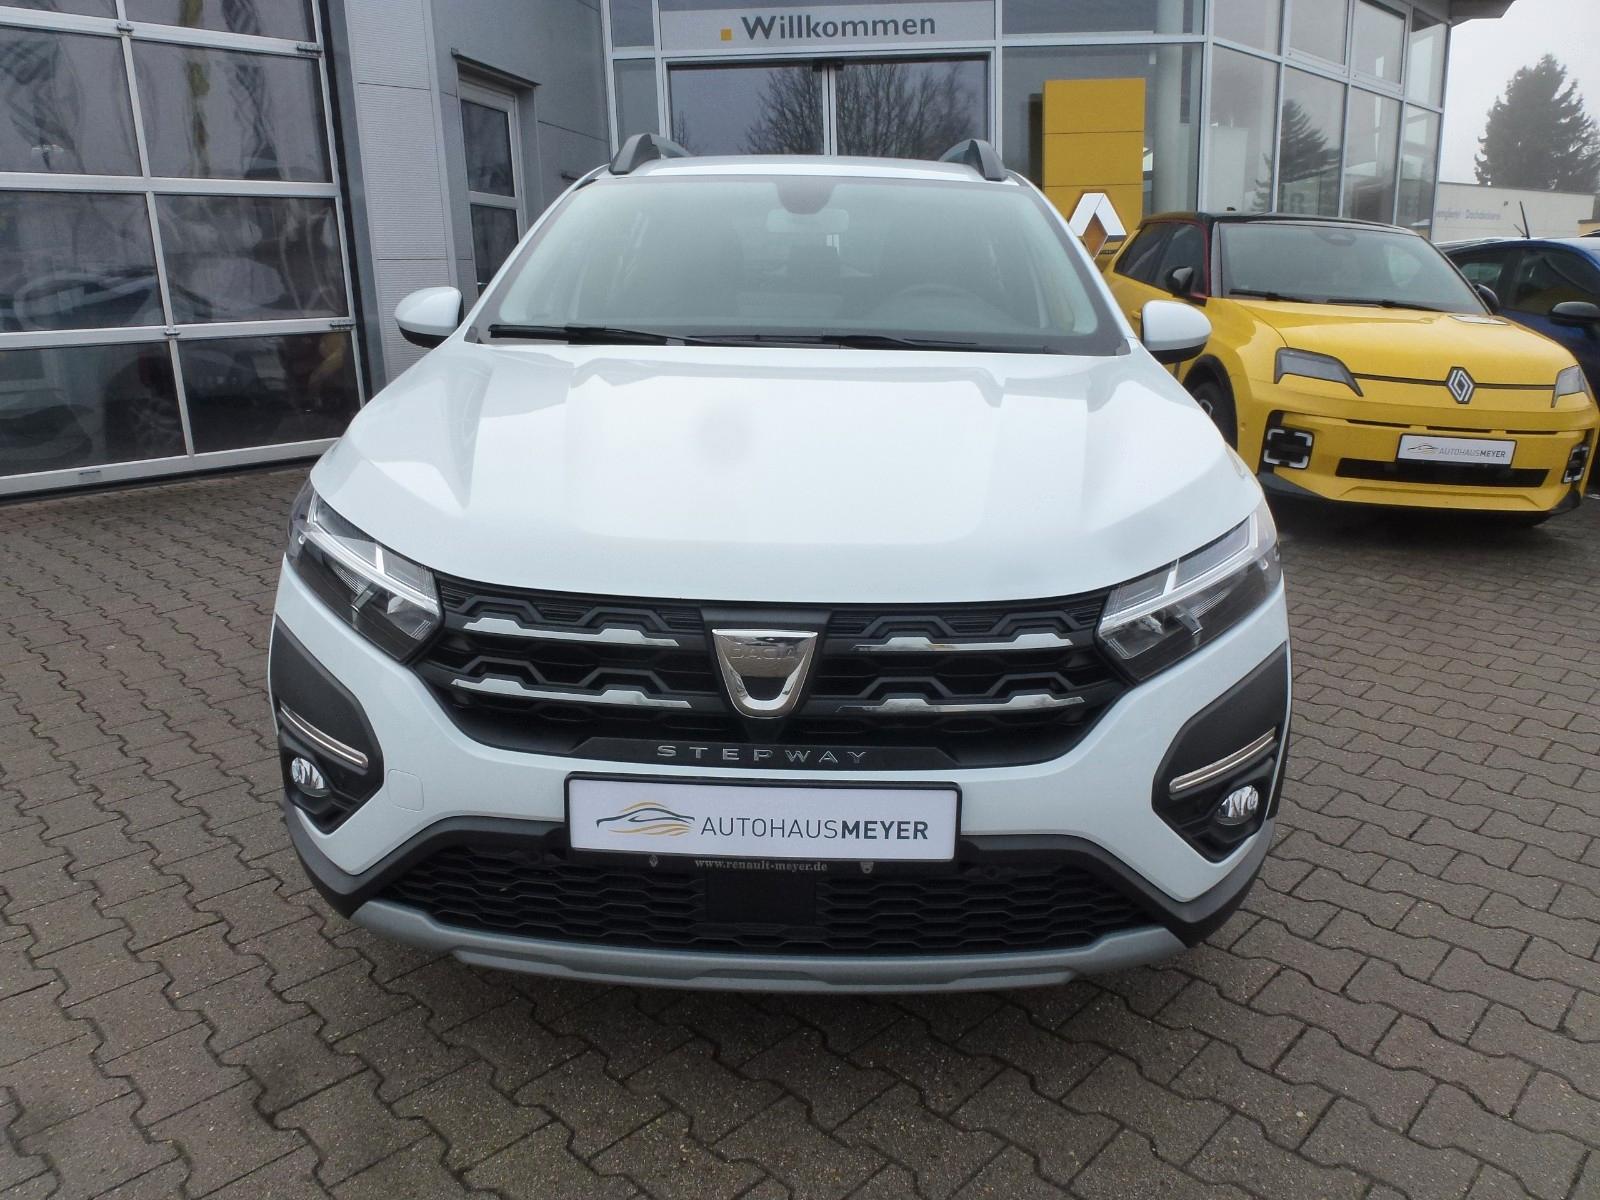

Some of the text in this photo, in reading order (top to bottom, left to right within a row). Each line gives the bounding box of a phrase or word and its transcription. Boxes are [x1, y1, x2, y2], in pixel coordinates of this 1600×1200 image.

[740, 14, 936, 41] Willkommen
[656, 745, 867, 764] STEPWAY
[700, 816, 929, 840] AUTOHAUSMEYER
[694, 858, 829, 873] www.renault-meyer.de
